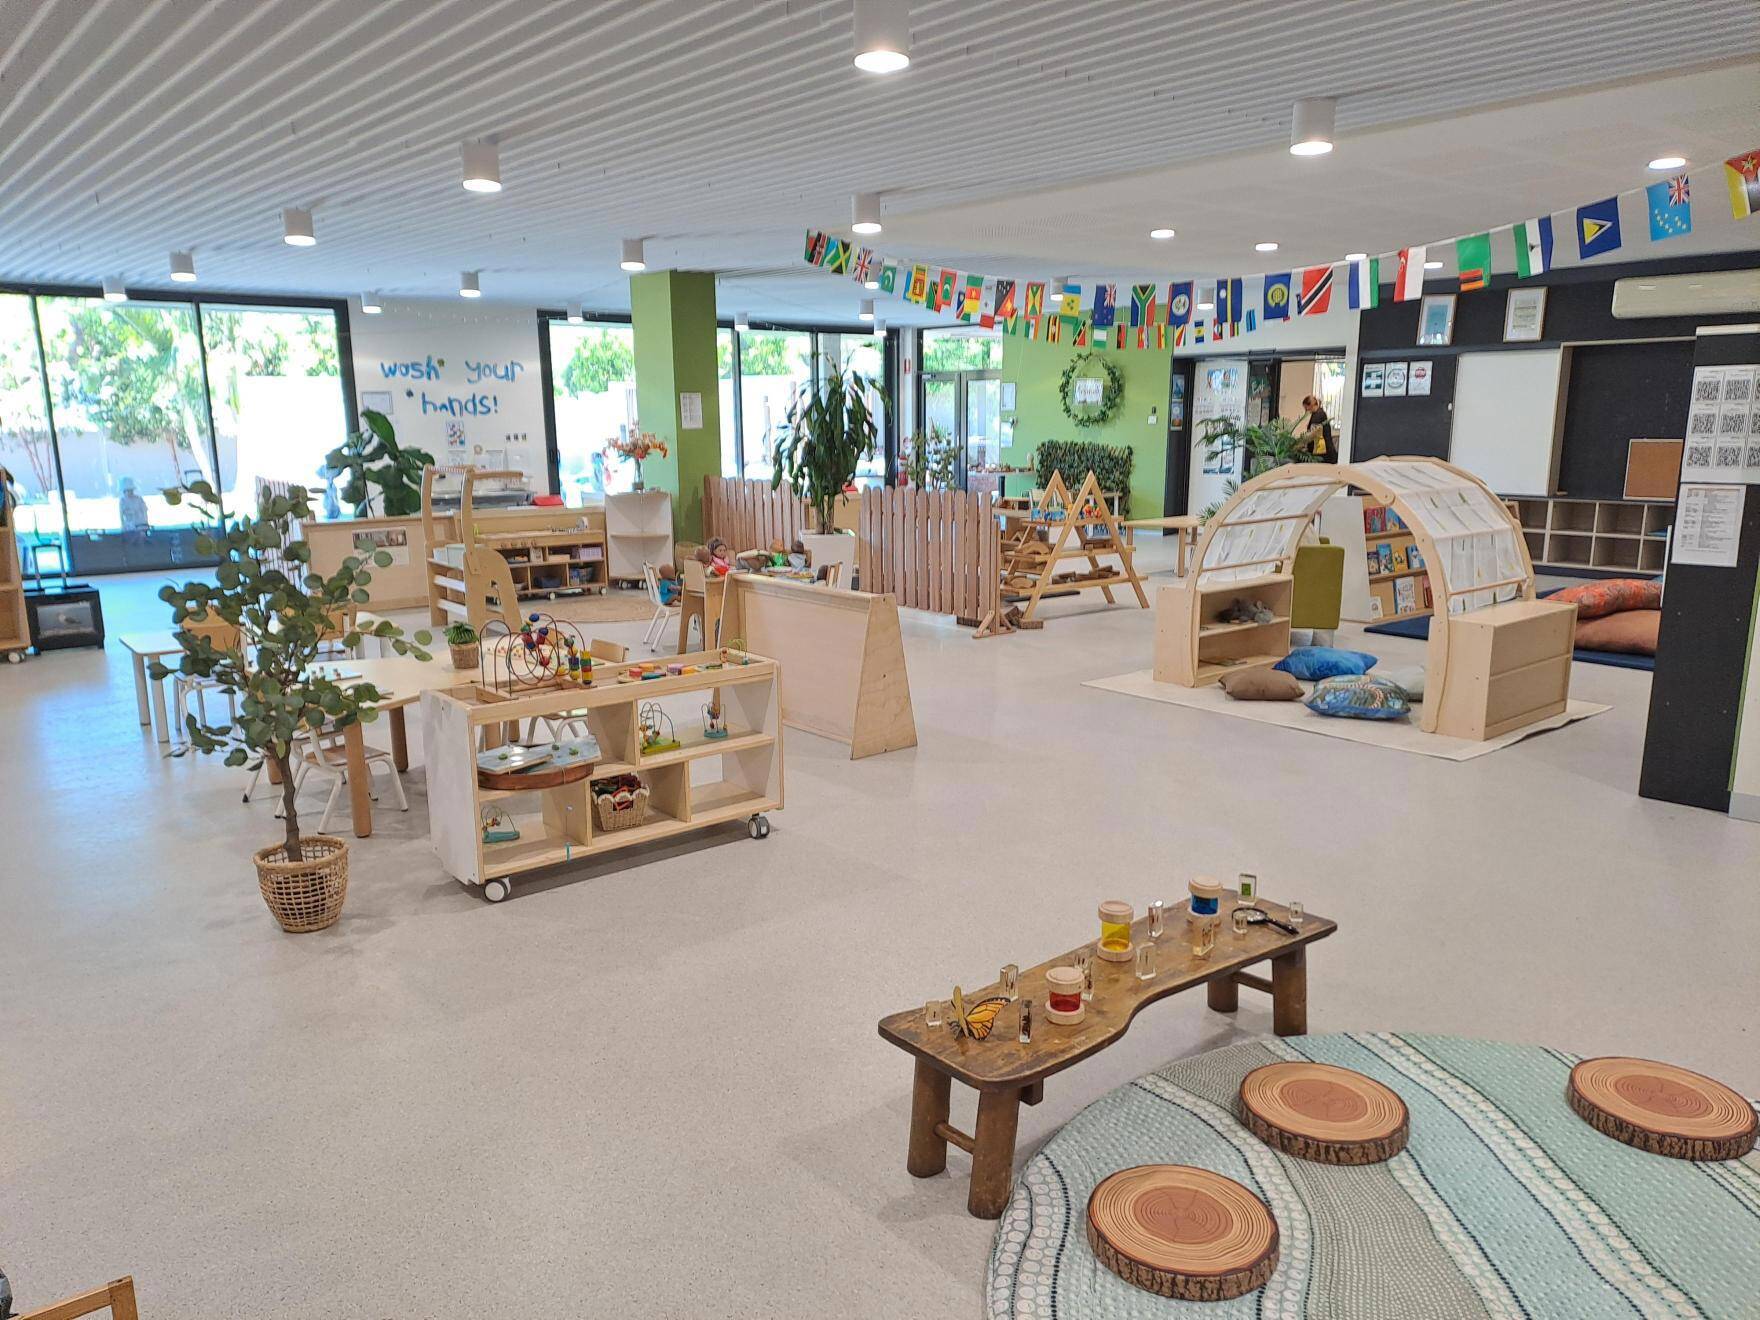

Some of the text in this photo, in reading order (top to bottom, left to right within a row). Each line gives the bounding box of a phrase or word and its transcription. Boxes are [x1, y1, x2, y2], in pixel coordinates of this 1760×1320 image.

[380, 355, 524, 384] wash your
[421, 392, 499, 417] hands!
